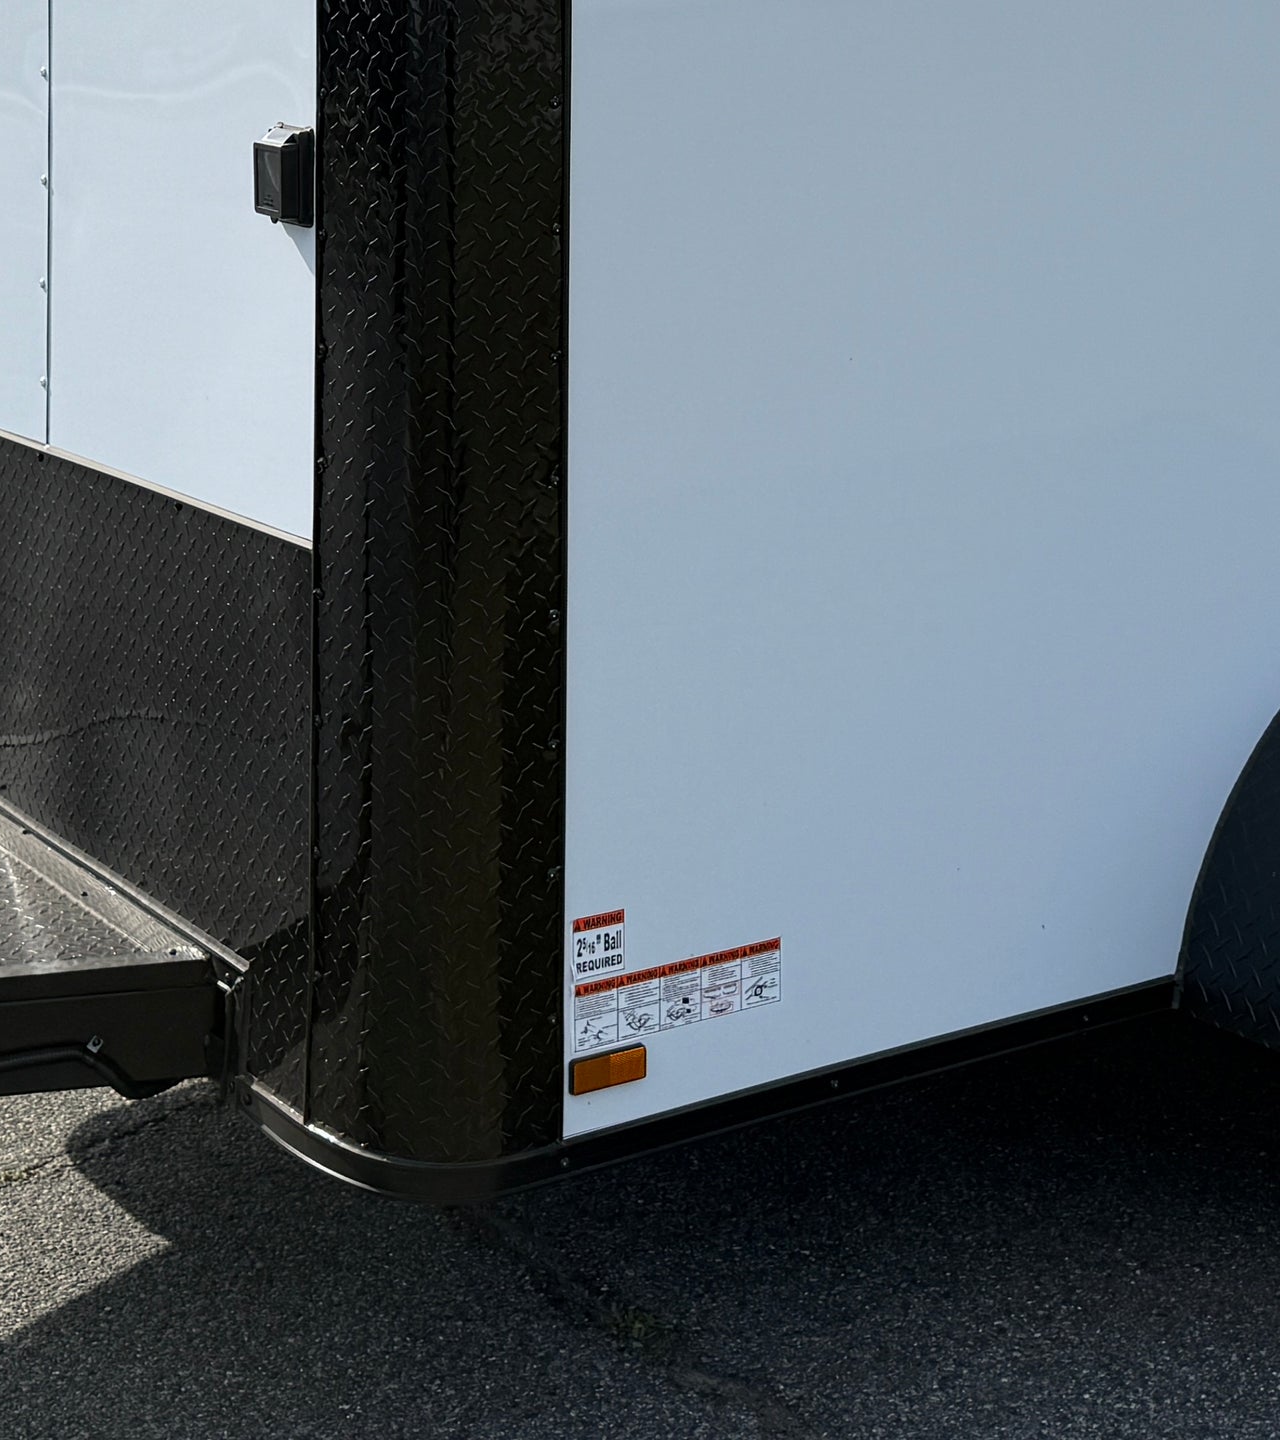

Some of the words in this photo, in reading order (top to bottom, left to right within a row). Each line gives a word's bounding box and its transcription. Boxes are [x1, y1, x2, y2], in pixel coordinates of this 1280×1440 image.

[584, 912, 622, 930] WARNING
[604, 930, 622, 952] Ball
[576, 953, 623, 974] REQUIRED
[626, 969, 658, 984] WARNING
[583, 978, 616, 994] WARNING
